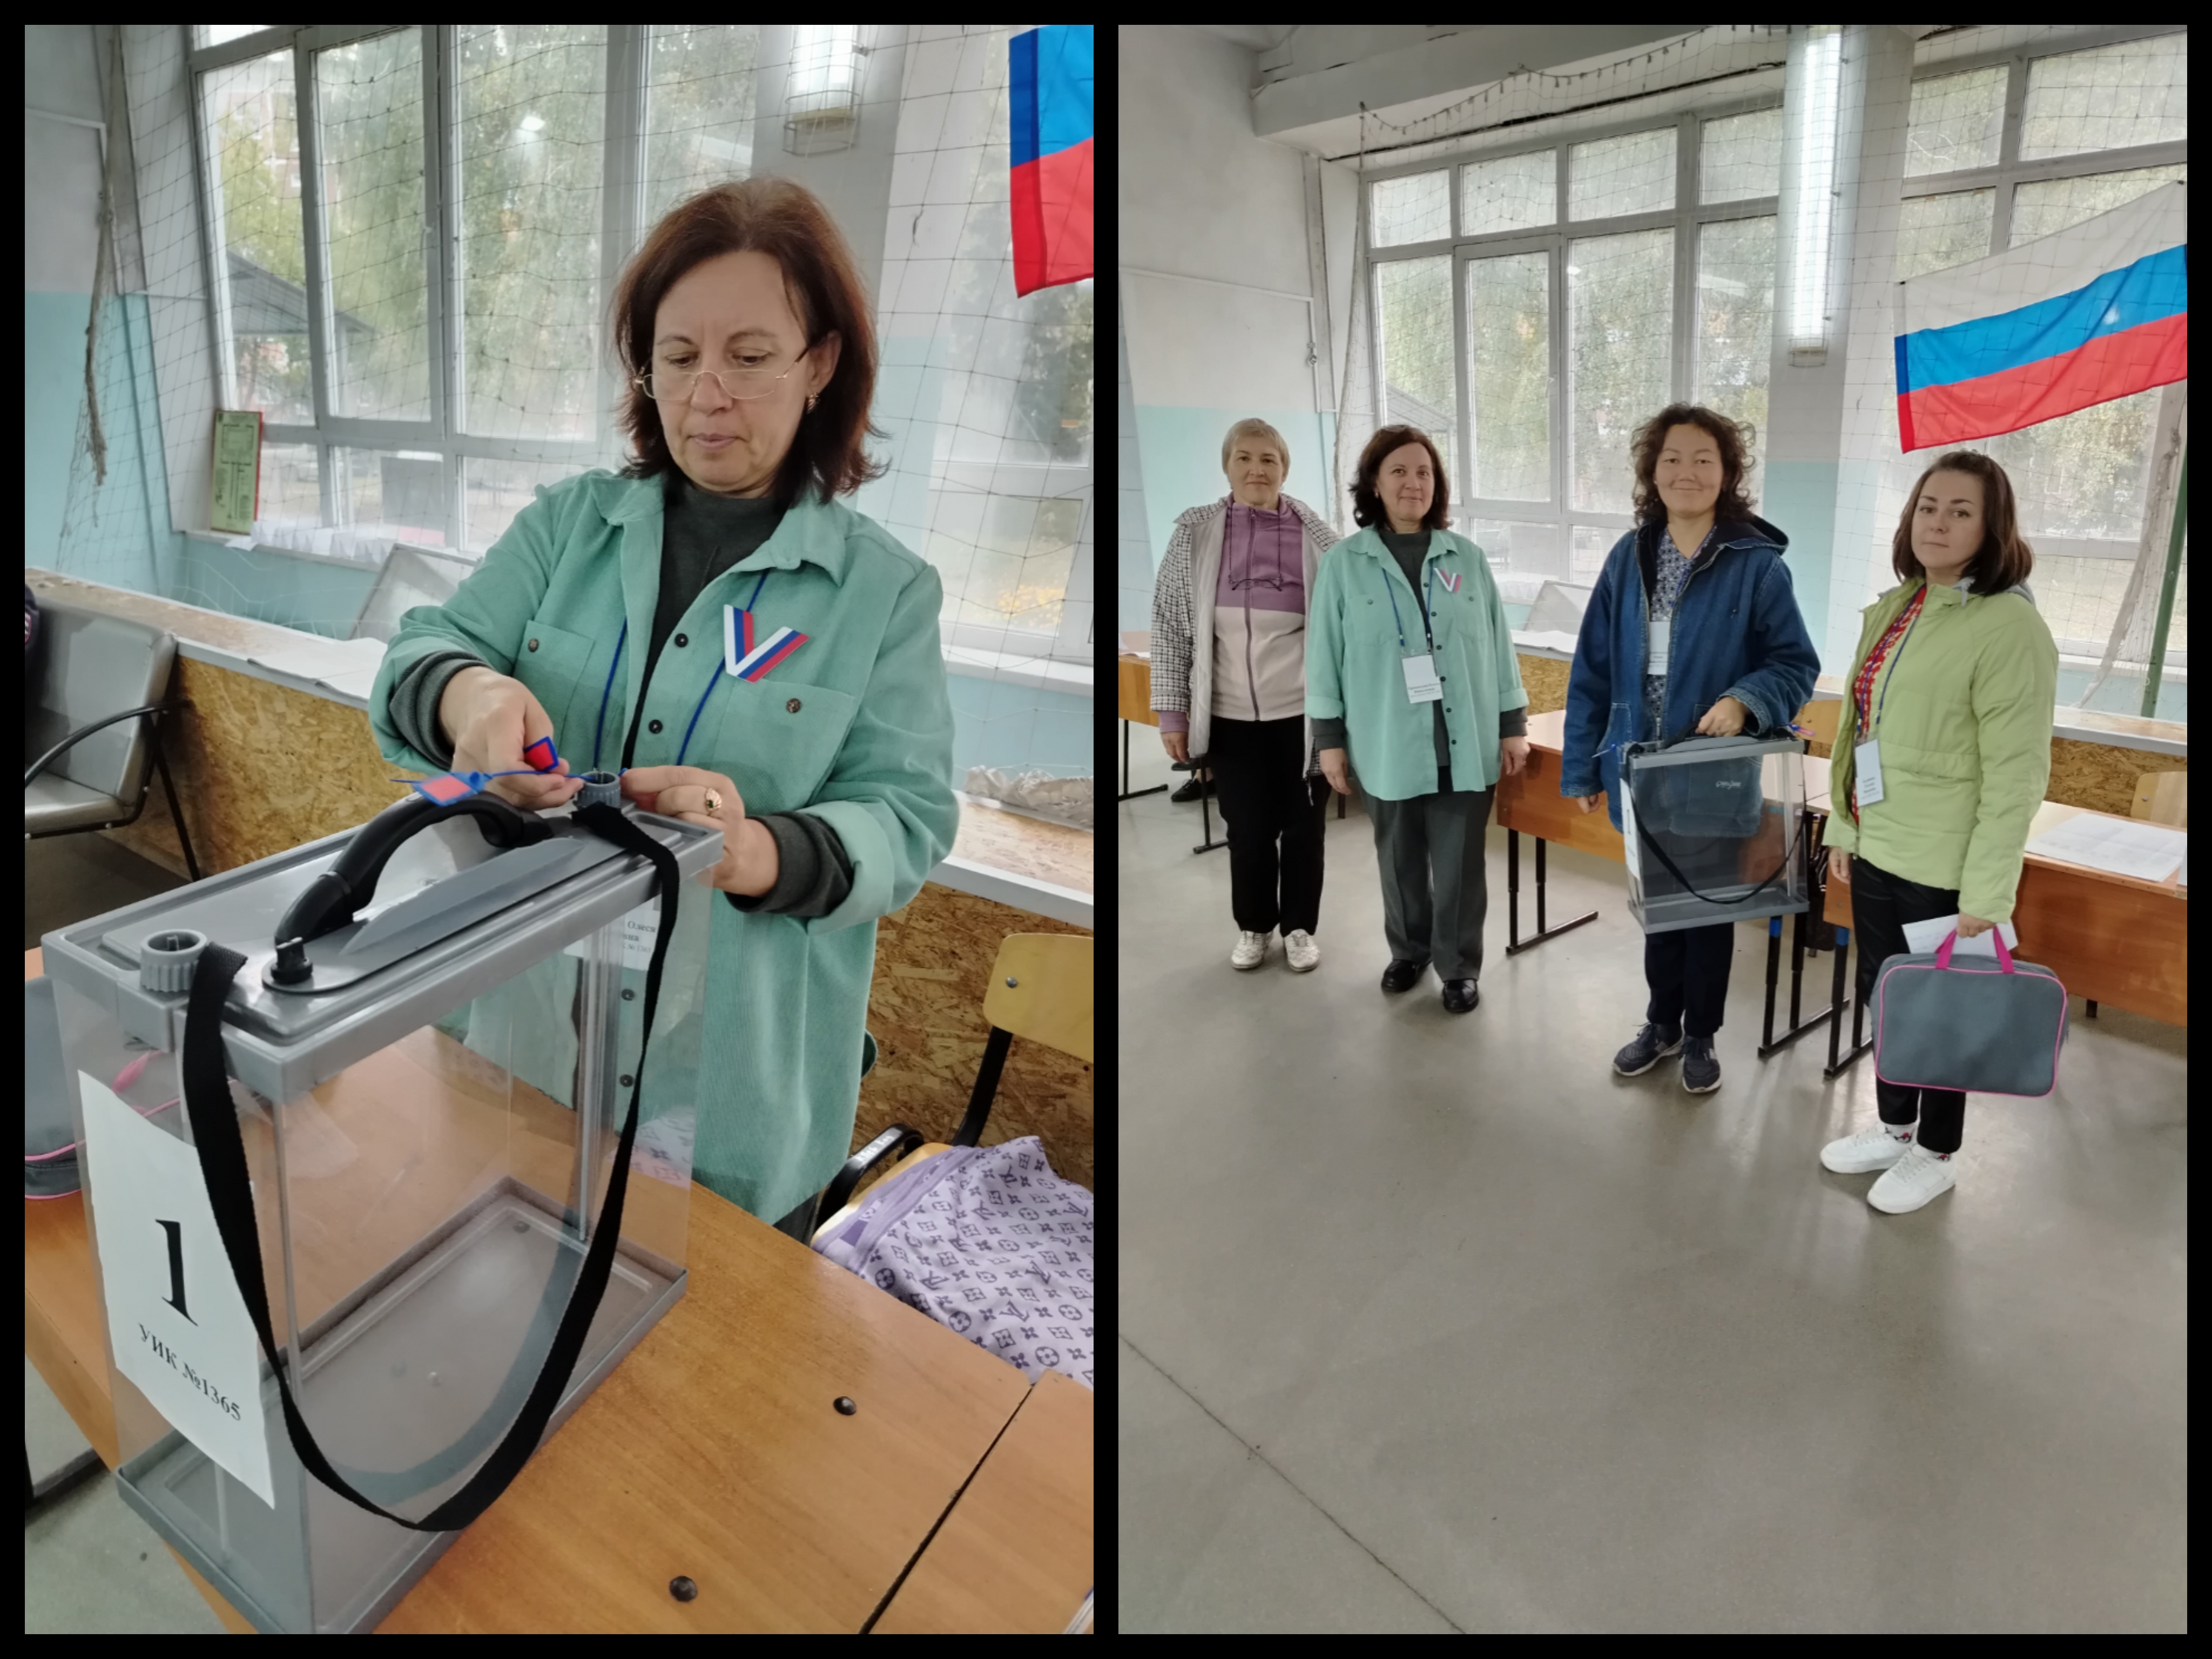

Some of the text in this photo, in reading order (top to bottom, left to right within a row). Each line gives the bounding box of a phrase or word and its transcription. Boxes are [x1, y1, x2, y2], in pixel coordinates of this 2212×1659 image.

[623, 933, 639, 942] вна
[627, 921, 656, 933] Олеся
[155, 1218, 198, 1327] 1
[138, 1323, 241, 1421] УИК №1365
